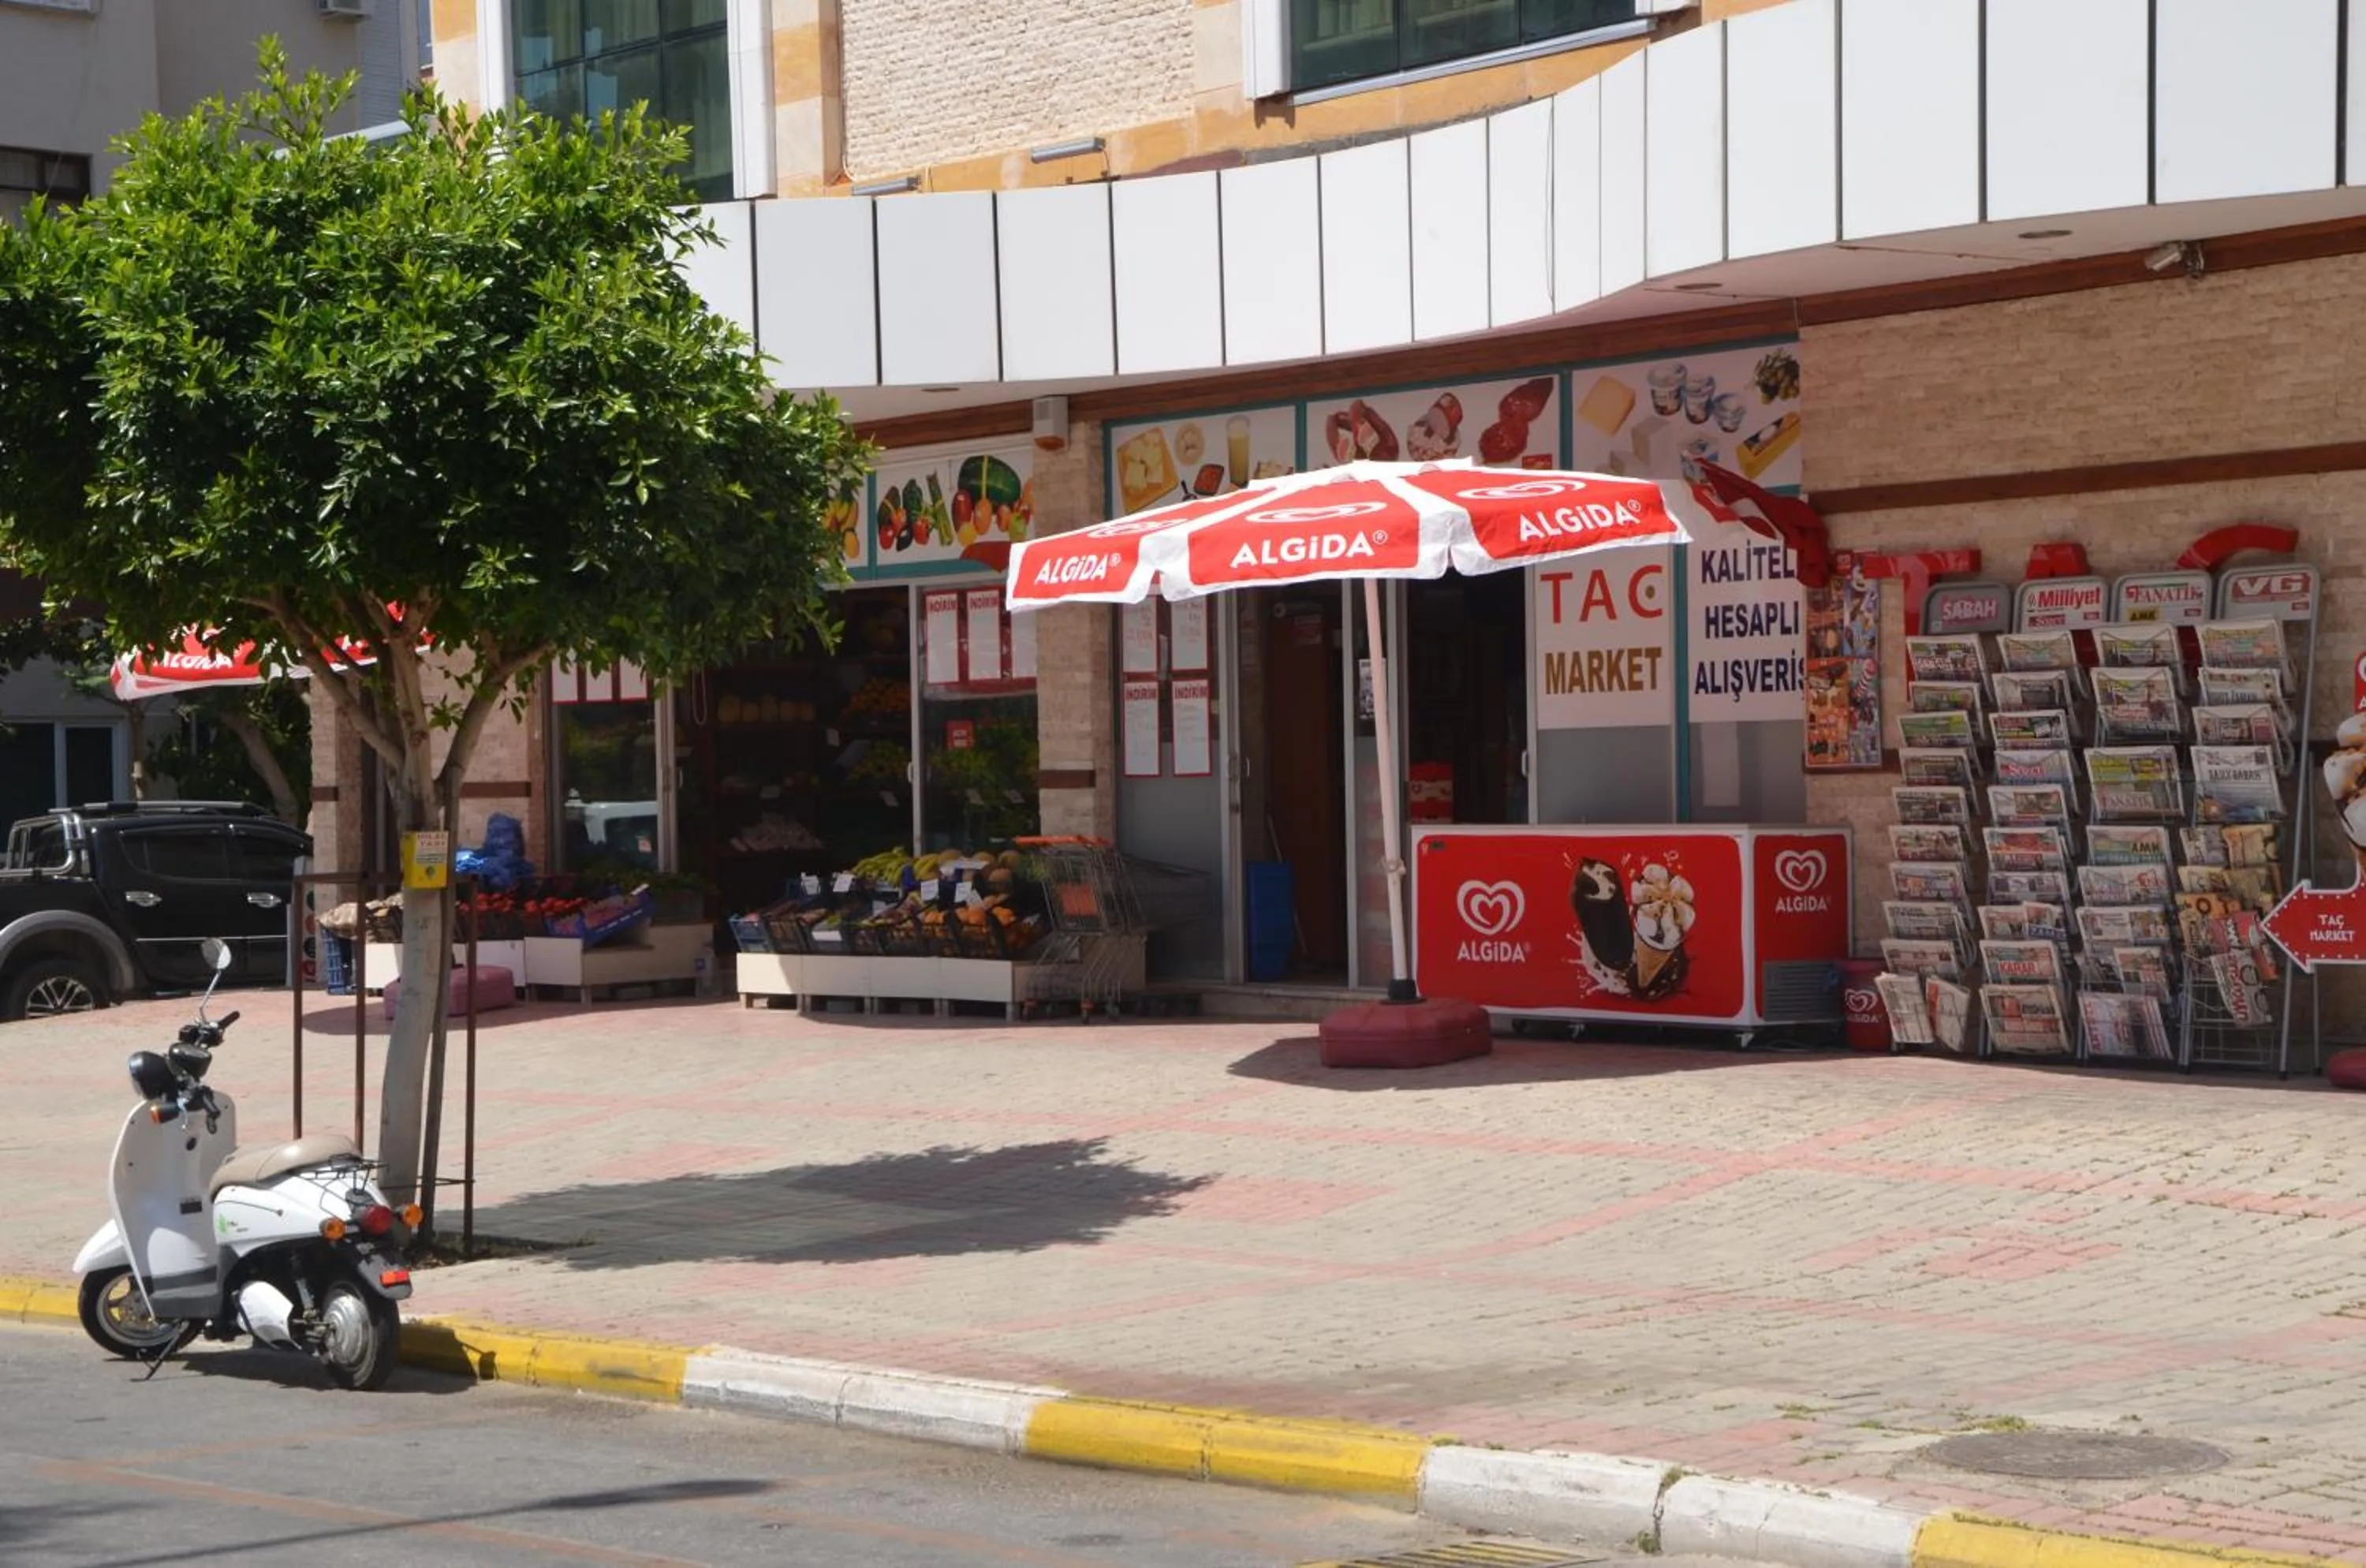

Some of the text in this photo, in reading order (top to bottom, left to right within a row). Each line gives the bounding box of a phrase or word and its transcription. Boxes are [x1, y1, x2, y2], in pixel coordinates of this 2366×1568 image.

[1701, 539, 1797, 583] KALİTEL
[2237, 575, 2301, 595] VG
[2038, 587, 2099, 610] Milliyet
[1706, 601, 1798, 639] HESAPLI
[1942, 599, 1996, 621] SABAH
[1545, 647, 1662, 694] MARKET
[2318, 914, 2345, 930] TAÇ
[2309, 929, 2356, 943] MARKET
